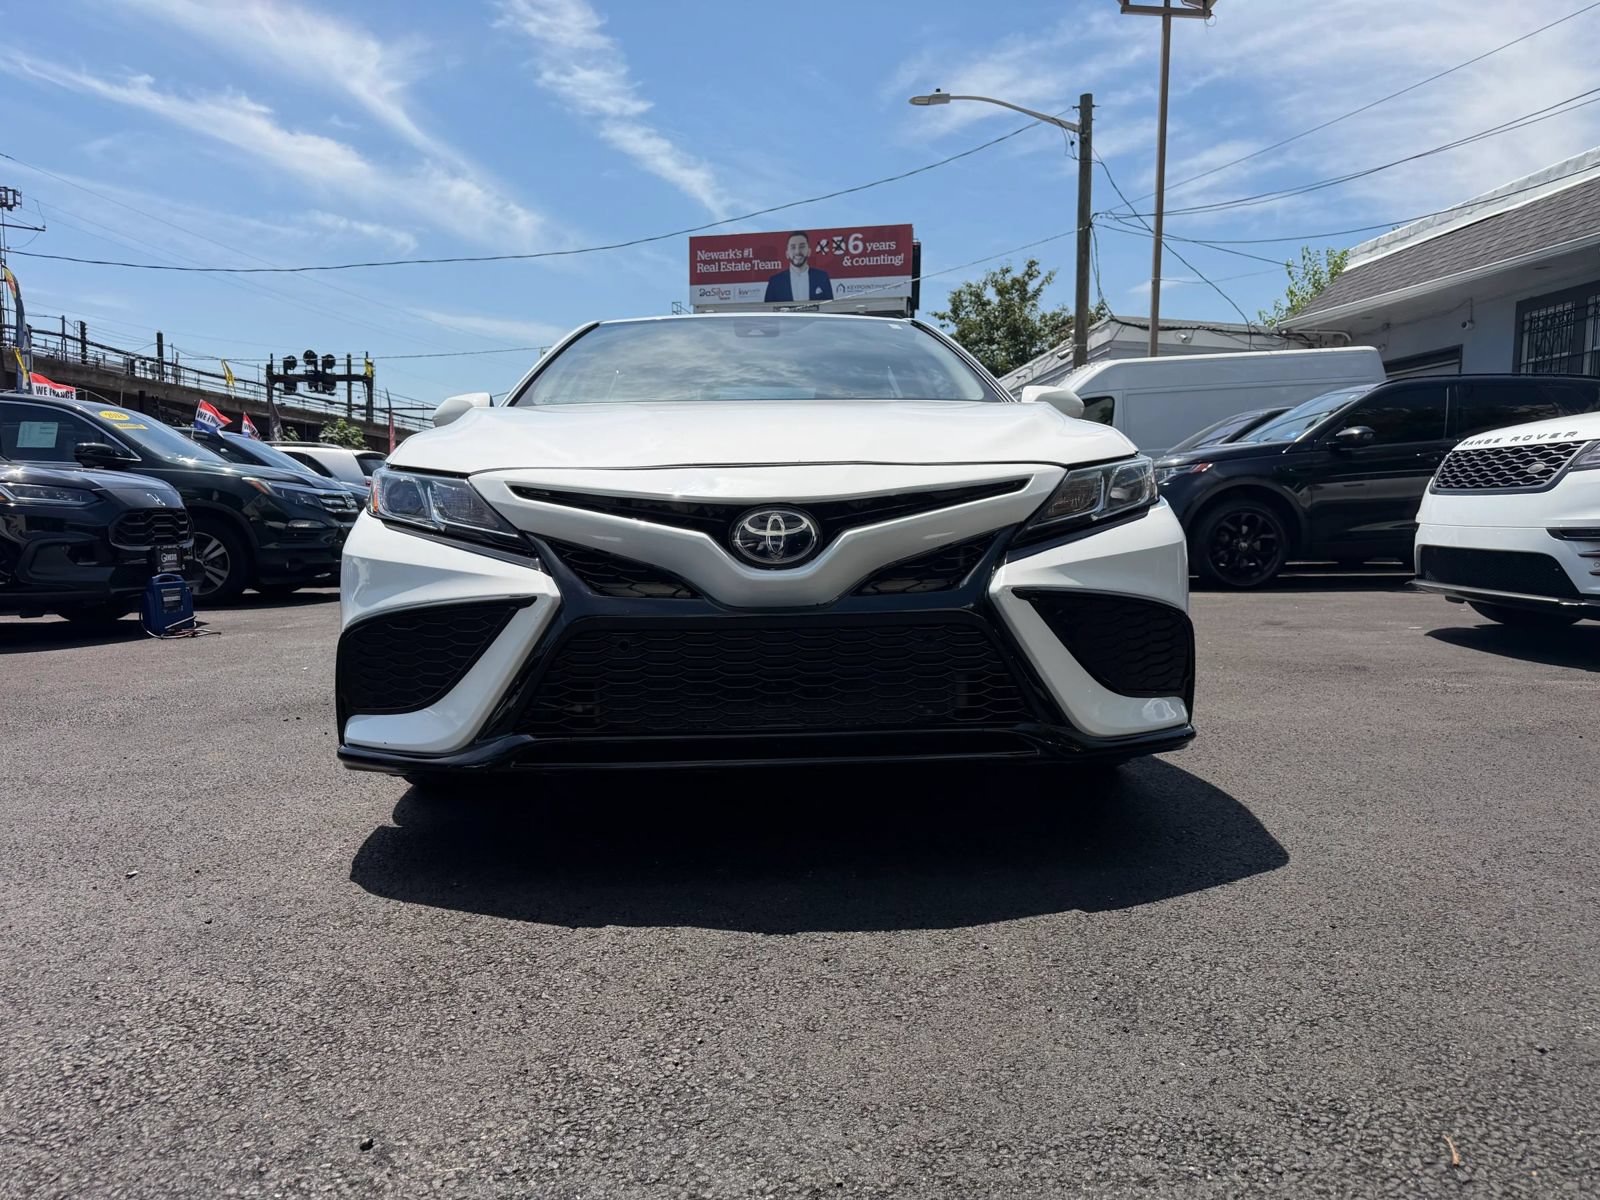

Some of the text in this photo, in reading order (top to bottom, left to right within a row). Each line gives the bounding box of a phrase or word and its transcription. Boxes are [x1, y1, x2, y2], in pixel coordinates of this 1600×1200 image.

[848, 233, 864, 254] 6
[866, 241, 896, 253] years
[696, 247, 754, 260] Newark's #1
[842, 252, 904, 267] & counting!
[696, 259, 782, 273] Real Estate Team
[35, 385, 48, 396] WE
[196, 409, 208, 421] WE
[1461, 430, 1578, 447] RANGE ROVER
